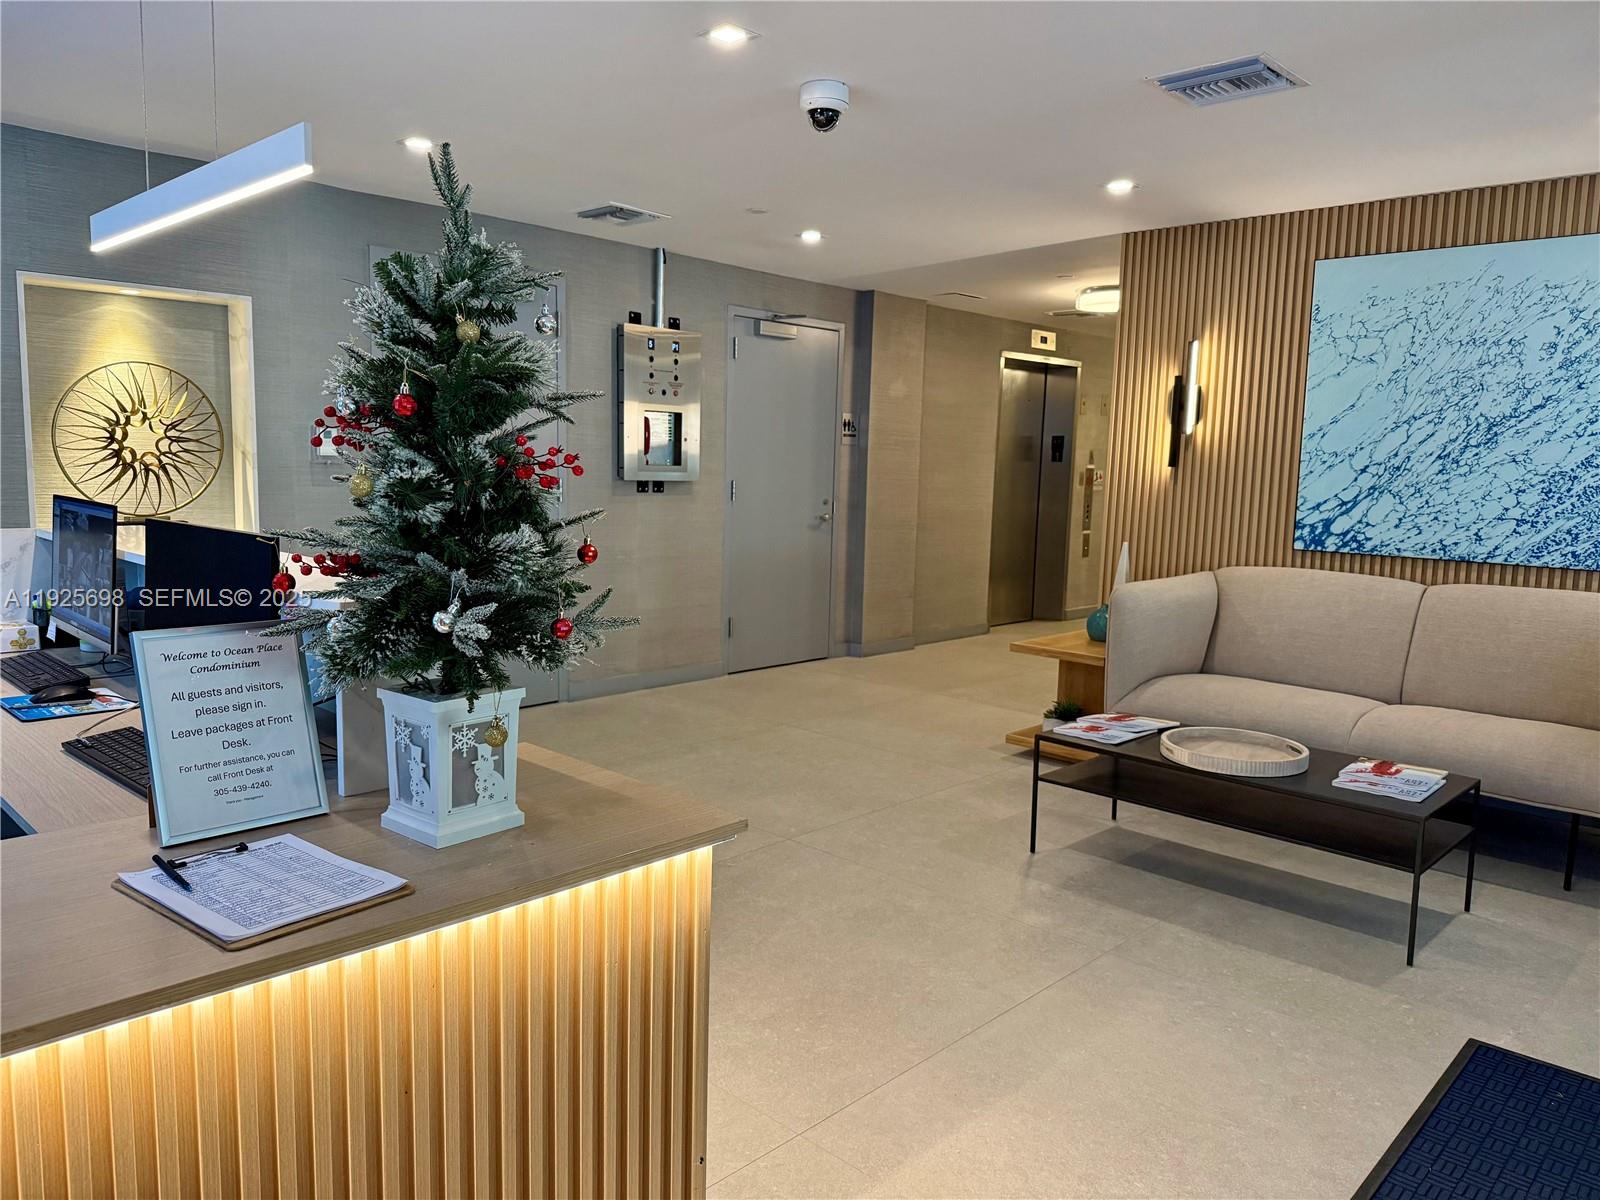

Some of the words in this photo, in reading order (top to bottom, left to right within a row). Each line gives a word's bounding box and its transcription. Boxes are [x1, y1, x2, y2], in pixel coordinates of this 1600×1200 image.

[160, 651, 208, 662] Welcome
[211, 649, 220, 658] to
[224, 647, 254, 657] Ocean
[256, 643, 283, 653] Place
[190, 660, 261, 674] Condominium
[171, 692, 185, 702] All
[187, 687, 222, 702] guests
[224, 685, 243, 695] and
[245, 681, 284, 693] visitors,
[195, 704, 230, 719] please
[232, 701, 253, 713] sign
[254, 699, 267, 709] in.
[171, 727, 203, 740] Leave
[205, 720, 254, 737] packages
[256, 718, 266, 727] at
[267, 714, 293, 726] Front
[222, 738, 252, 750] Desk.
[179, 765, 193, 774] For
[194, 761, 221, 772] further
[222, 754, 266, 767] assistance,
[266, 752, 280, 761] you
[281, 748, 295, 757] can
[207, 773, 222, 783] call
[223, 770, 244, 780] Front
[245, 766, 265, 776] Desk
[265, 764, 274, 772] at
[213, 780, 273, 797] 305-439-4240.
